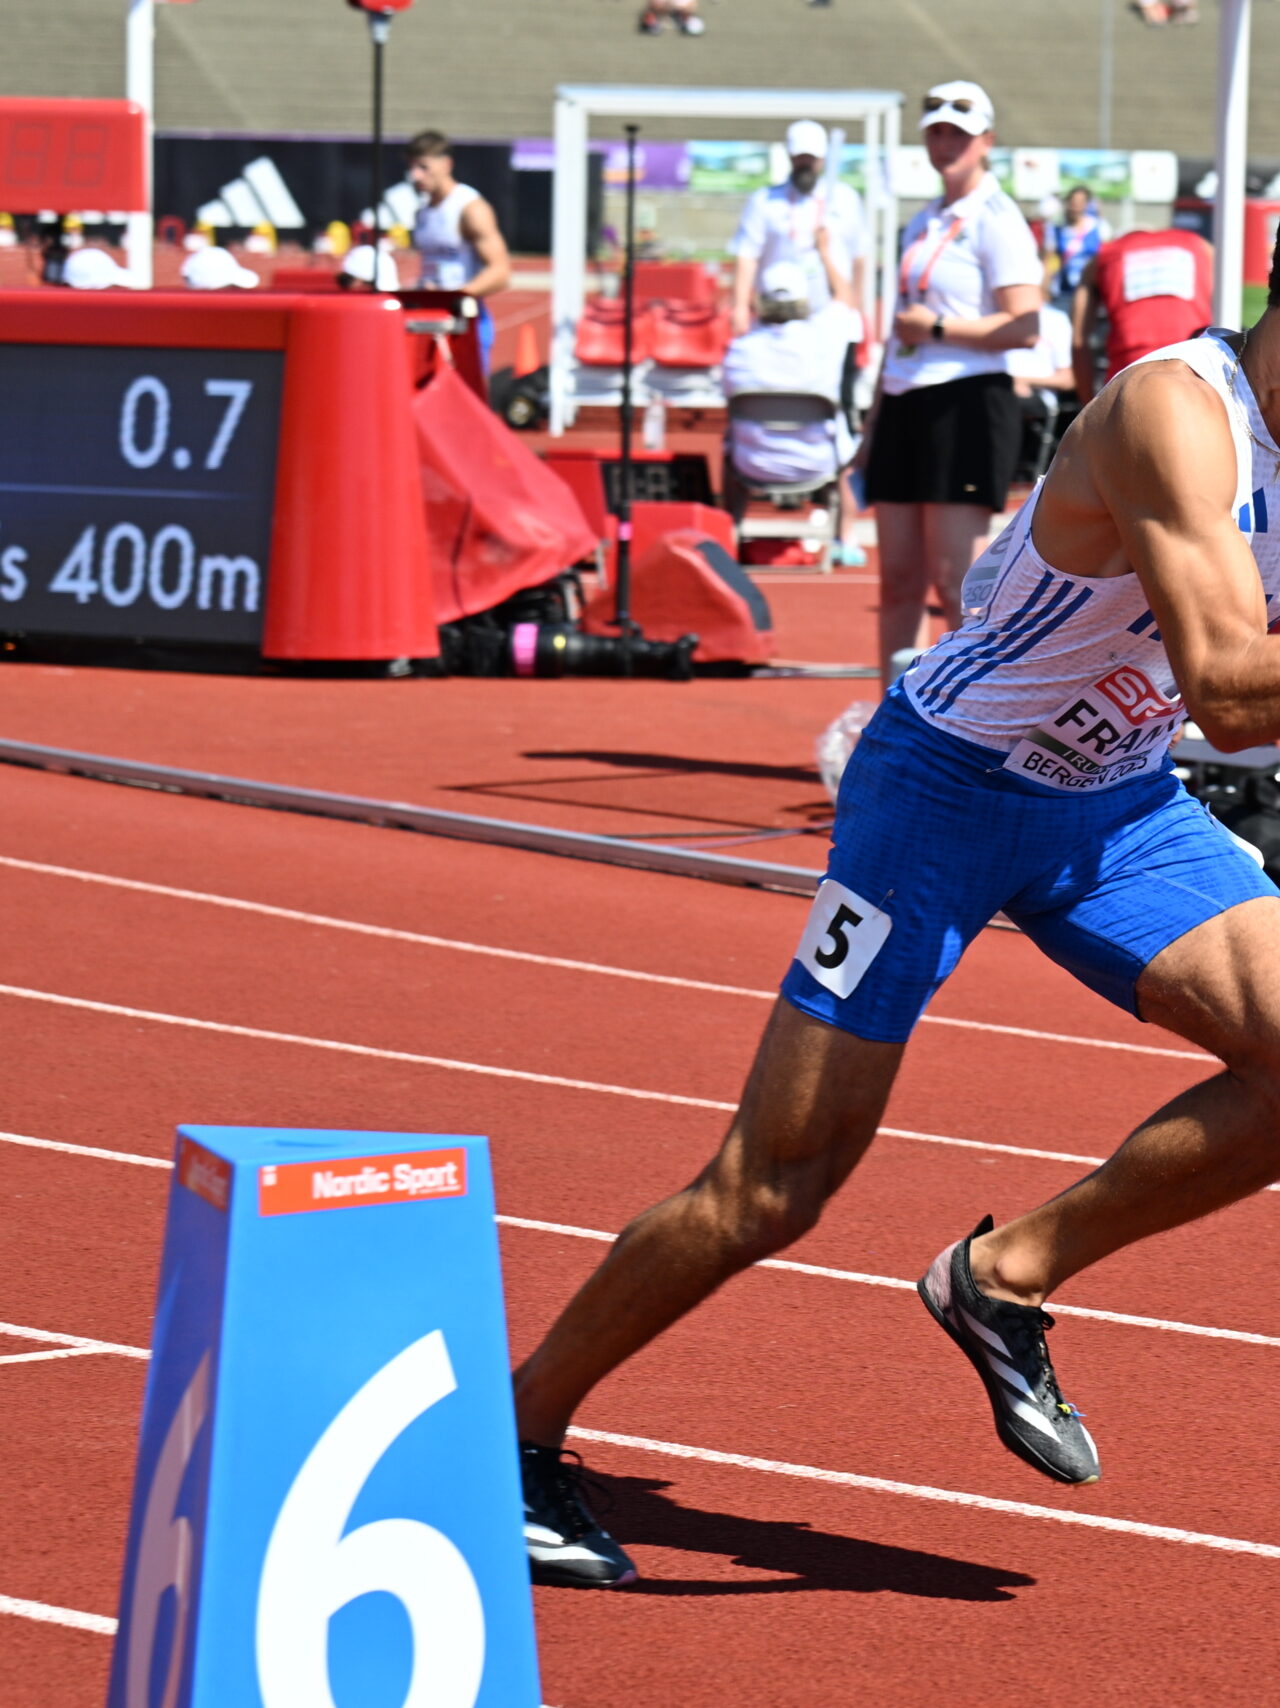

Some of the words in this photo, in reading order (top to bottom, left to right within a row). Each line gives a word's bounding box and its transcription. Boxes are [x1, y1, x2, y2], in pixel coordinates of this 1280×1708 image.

[119, 375, 253, 470] 0.7
[0, 546, 28, 601] s
[48, 521, 260, 612] 400m
[1022, 751, 1110, 788] BERGEN
[814, 903, 862, 969] 5
[312, 1171, 390, 1199] Nordic
[393, 1162, 458, 1195] Sport
[256, 1329, 487, 1708] 6
